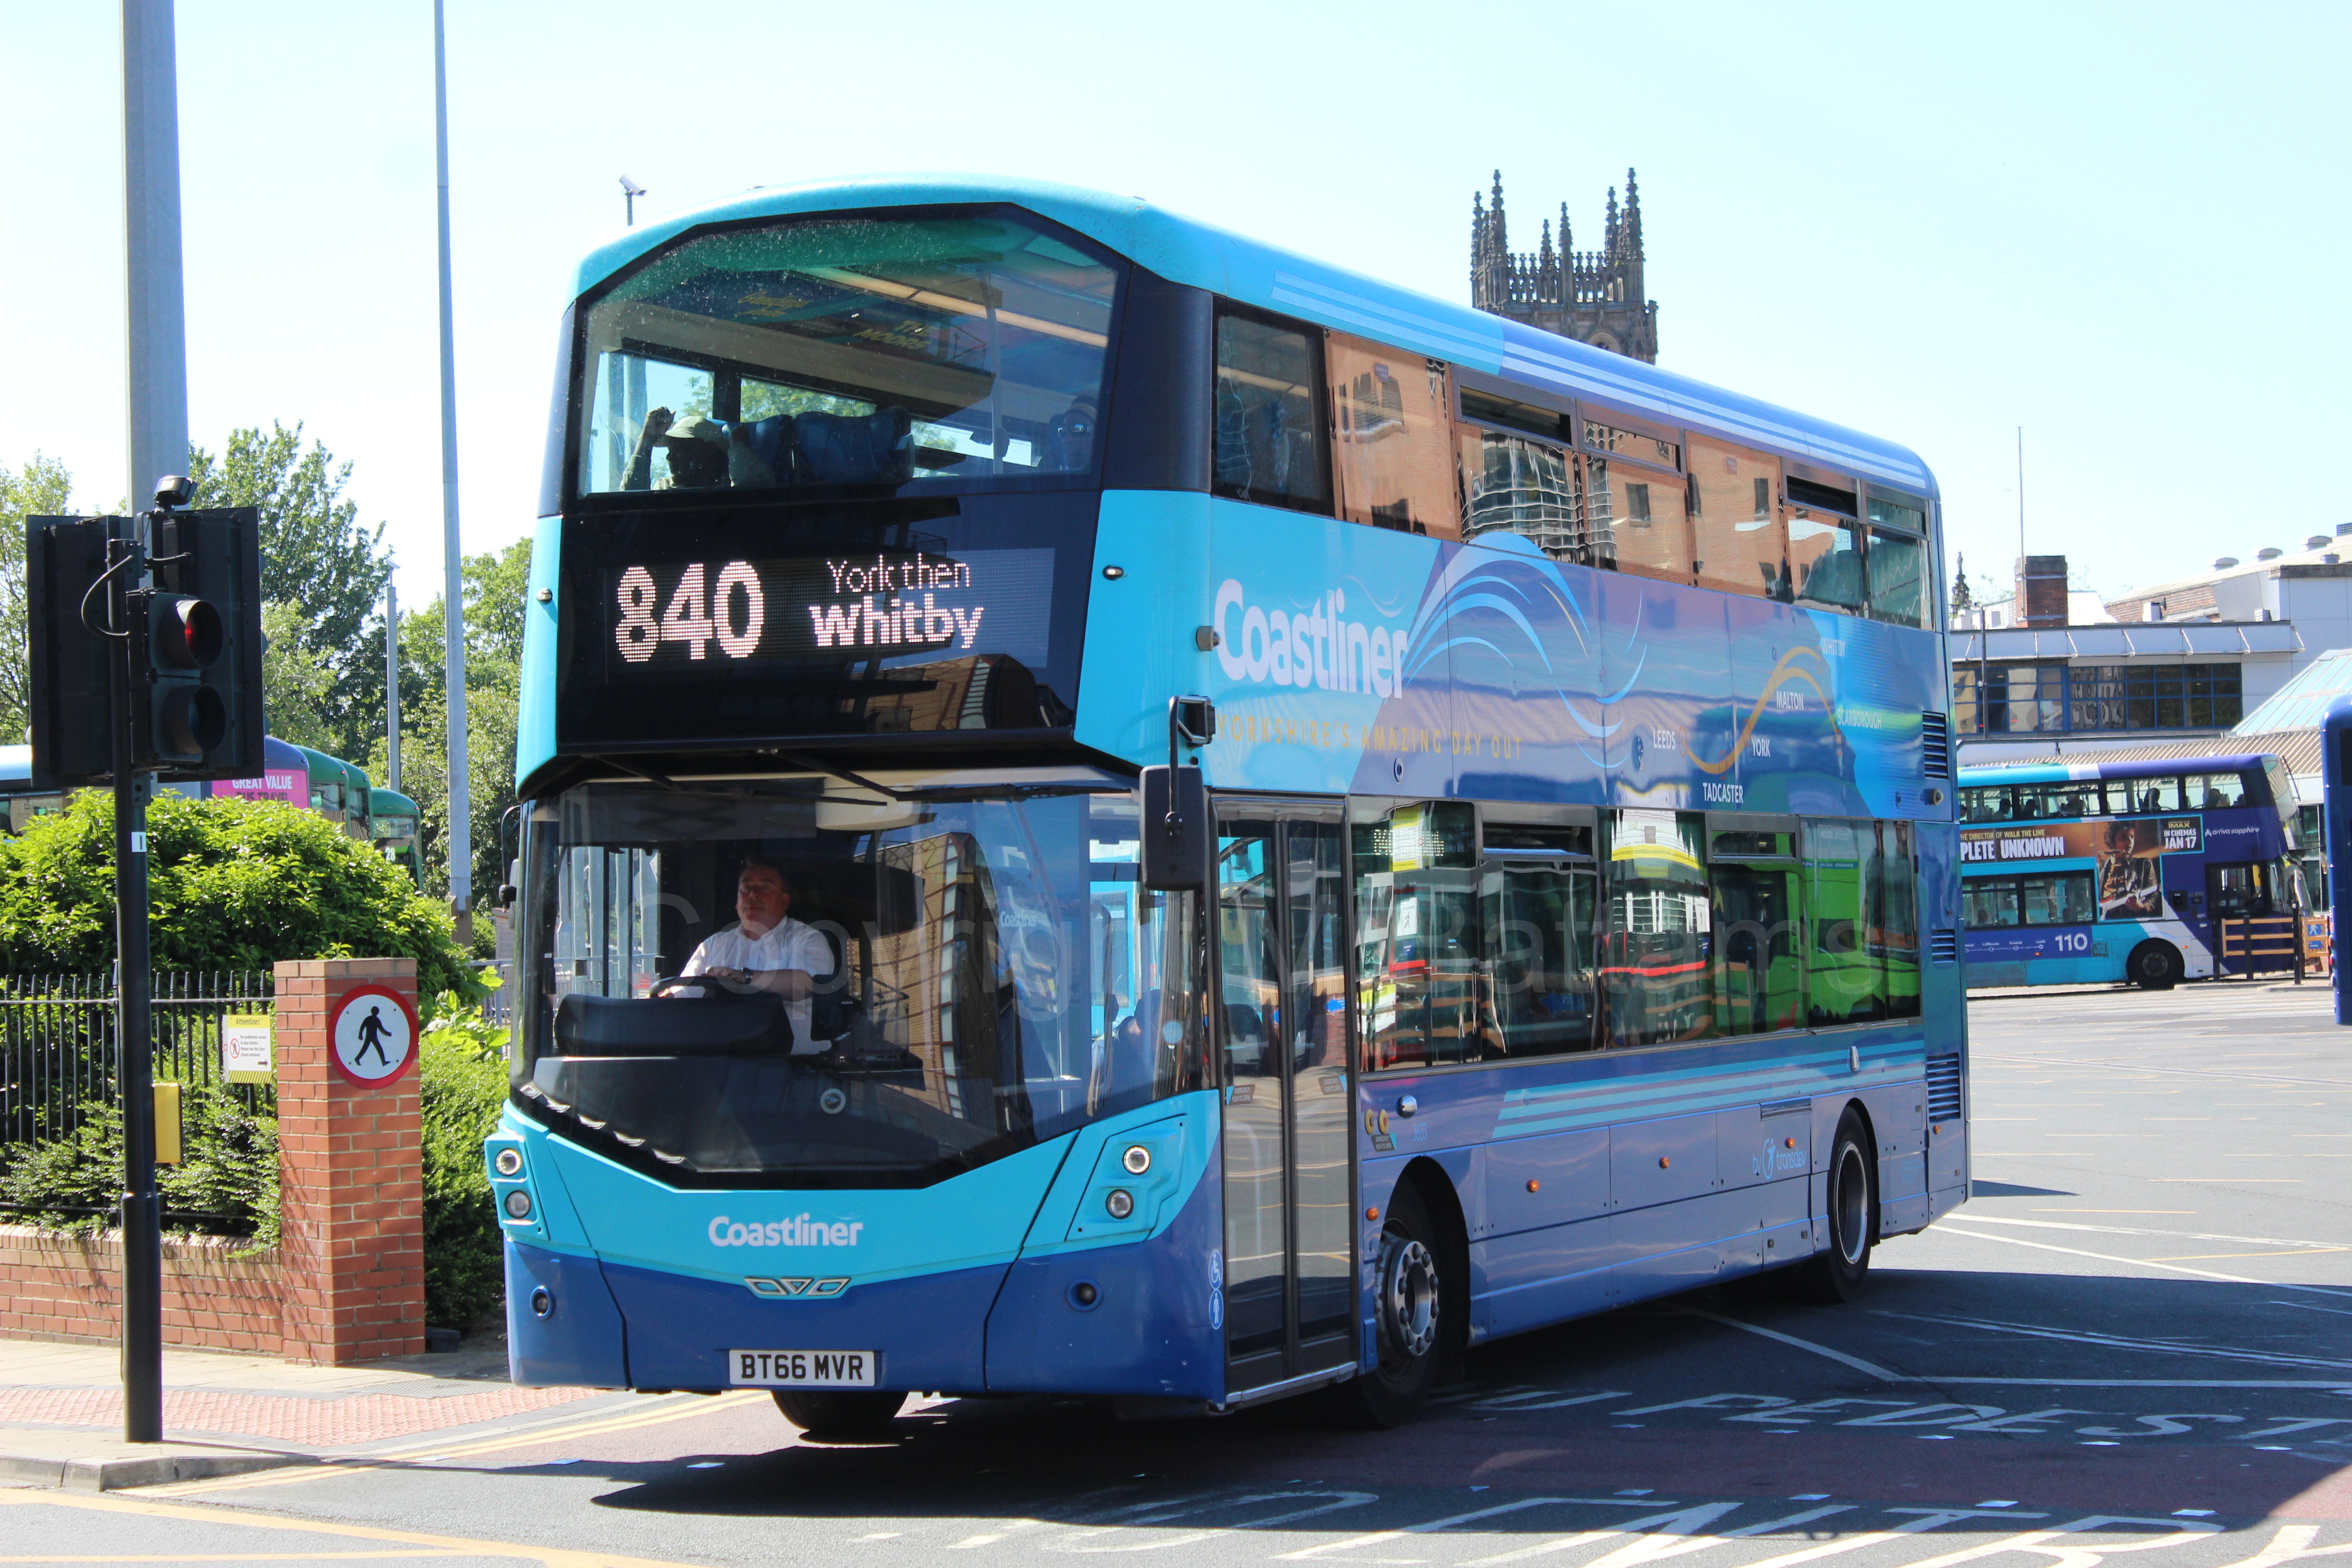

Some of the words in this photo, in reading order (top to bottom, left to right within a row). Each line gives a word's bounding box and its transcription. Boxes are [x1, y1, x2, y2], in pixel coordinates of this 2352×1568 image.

[853, 328, 931, 349] MOORS
[826, 554, 895, 593] York
[901, 552, 970, 590] then
[615, 560, 765, 663] 840
[808, 593, 985, 649] Whitby
[1214, 578, 1407, 699] Coastliner
[1821, 637, 1846, 658] WHITBY
[1776, 691, 1804, 710] MALTON
[1837, 708, 1882, 730] SCARBOROUGH
[1216, 713, 1350, 749] YORKSHIRE'S
[1362, 726, 1442, 754] AMAZING
[1453, 732, 1482, 757] DAY
[1492, 735, 1522, 760] OUT
[1653, 730, 1676, 750] LEEDS
[1752, 738, 1770, 757] YORK
[232, 779, 263, 789] GREAT
[265, 775, 293, 790] VALUE
[1702, 782, 1744, 804] TADCASTER
[1969, 832, 1994, 840] DIRECTOR
[2004, 830, 2020, 838] WALK
[2171, 828, 2197, 837] CINEMAS
[2231, 827, 2260, 835] sapphire
[1960, 841, 1995, 862] PLETE
[1999, 837, 2064, 859] UNKNOWN
[2165, 837, 2184, 849] JAN
[2185, 836, 2197, 849] 17
[385, 847, 396, 862] 28
[2055, 933, 2088, 952] 110
[1412, 1122, 1427, 1141] 3633
[1753, 1153, 1761, 1174] by
[1776, 1147, 1807, 1170] transdev
[708, 1212, 863, 1247] Coastliner
[740, 1354, 806, 1379] BT66
[814, 1354, 863, 1380] MVR
[1609, 1392, 2352, 1440] PEDEST
